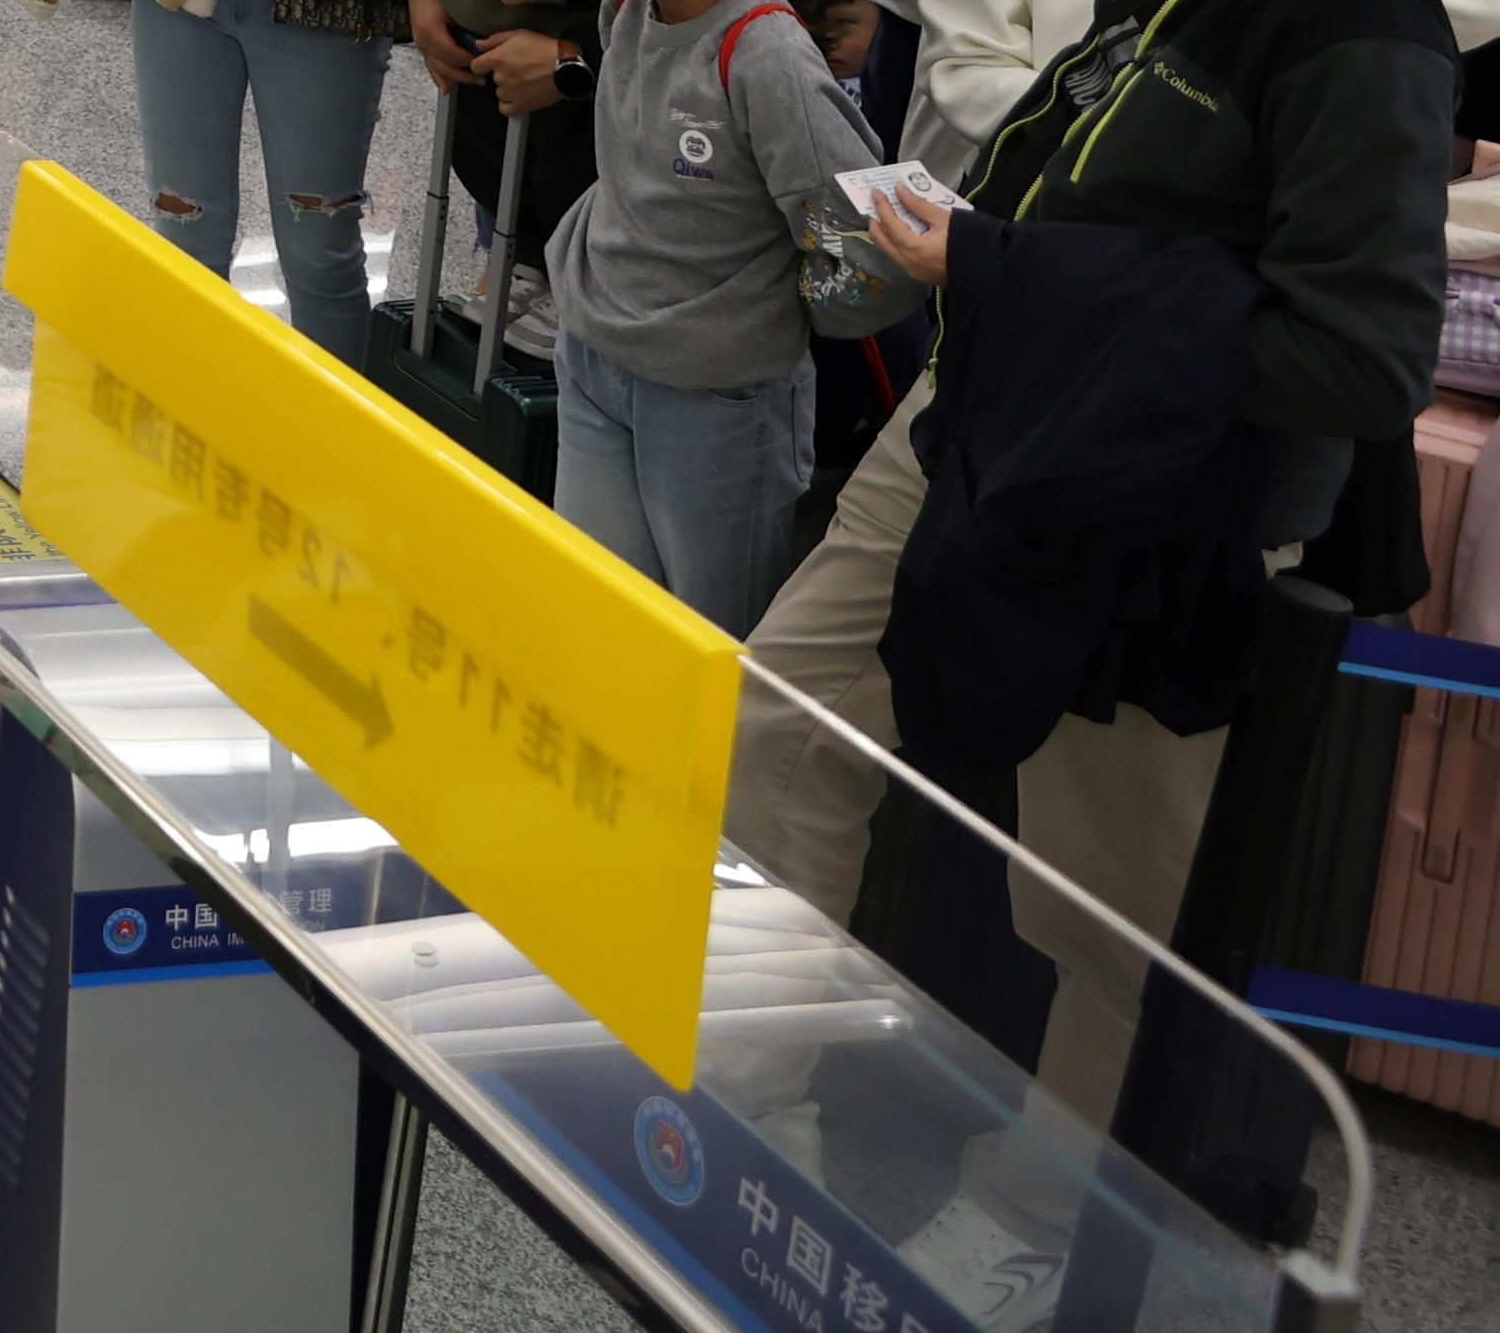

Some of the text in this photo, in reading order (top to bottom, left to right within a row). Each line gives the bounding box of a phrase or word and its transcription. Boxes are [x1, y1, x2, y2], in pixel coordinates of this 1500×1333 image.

[1161, 67, 1220, 113] Columbia
[6, 507, 42, 540] Yellow
[170, 932, 220, 950] CHINA
[737, 1175, 931, 1333] 中国移
[740, 1247, 823, 1333] CHINA
